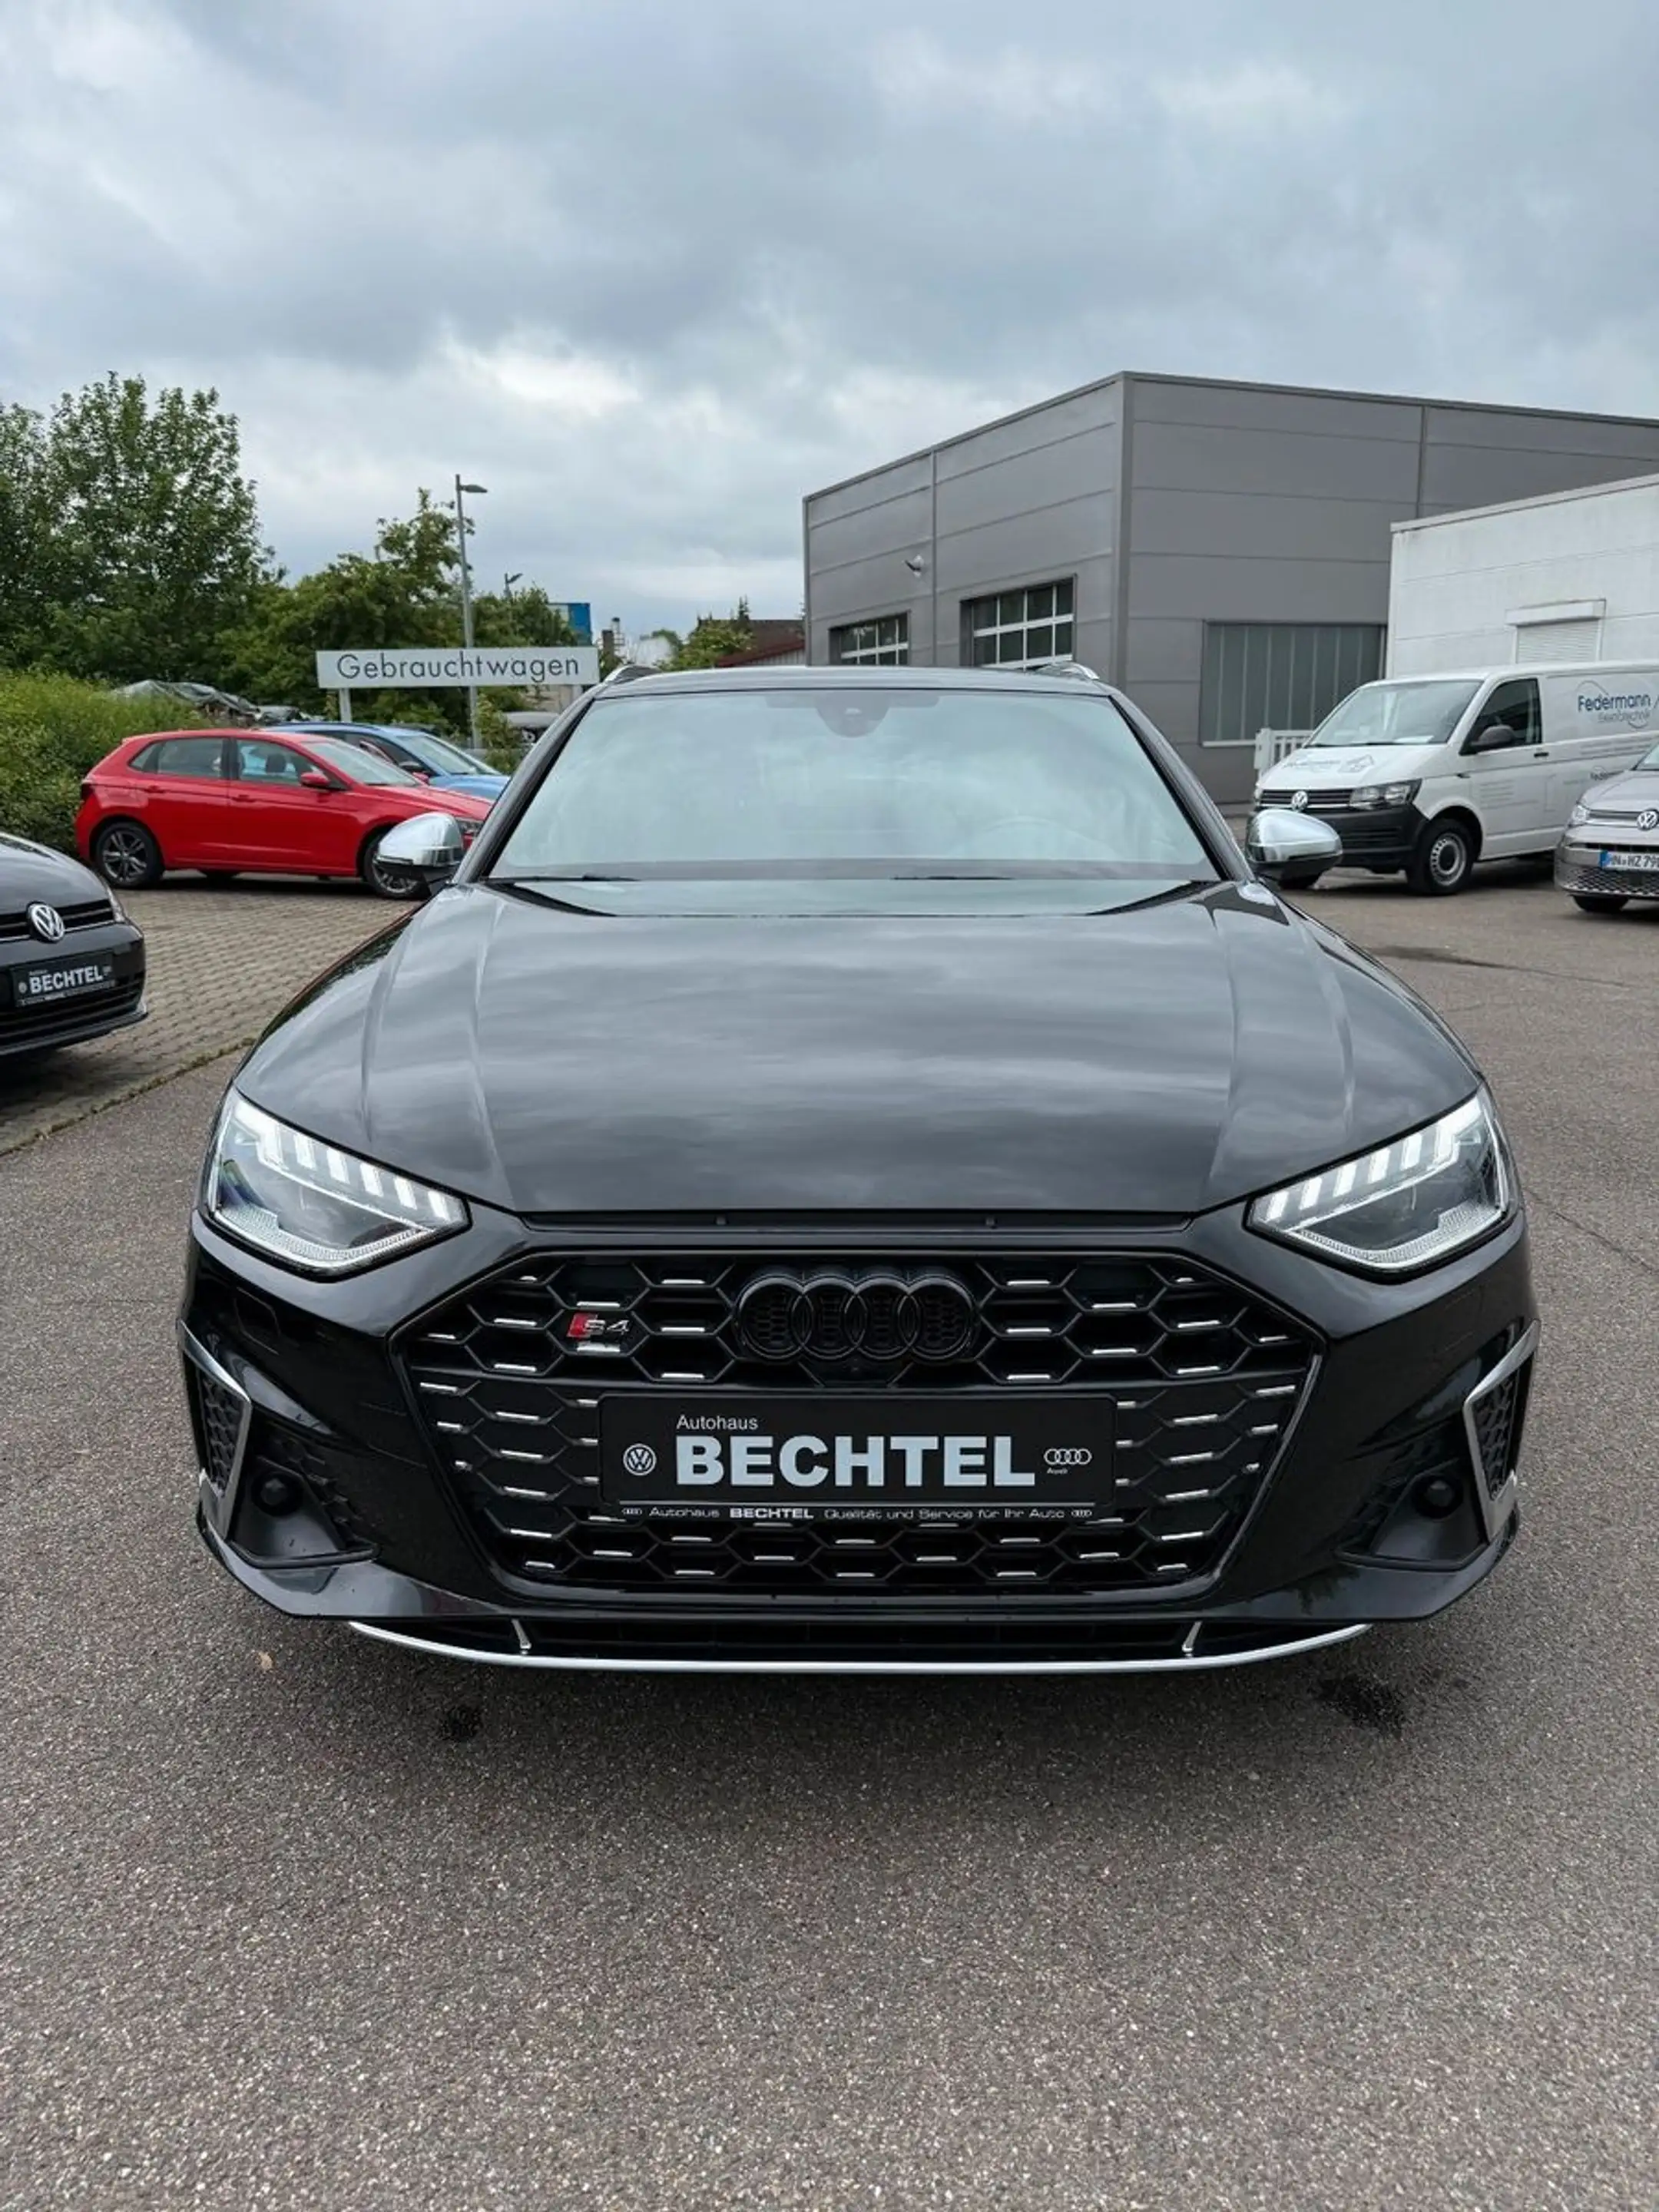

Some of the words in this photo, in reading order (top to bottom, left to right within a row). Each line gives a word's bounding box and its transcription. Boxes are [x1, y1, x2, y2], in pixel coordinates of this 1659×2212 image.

[336, 651, 579, 682] Gebrauchtwagen
[1578, 694, 1651, 712] Federmann
[28, 965, 103, 994] BECHTEL
[676, 1415, 758, 1430] Autohaus
[676, 1435, 1035, 1487] BECHTEL
[649, 1507, 720, 1518] Autohaus
[730, 1508, 814, 1518] BECHTEL
[824, 1508, 882, 1520] Qualität
[886, 1508, 913, 1519] und
[919, 1508, 973, 1519] Service
[979, 1508, 999, 1519] für
[1004, 1508, 1025, 1519] Ihr
[1028, 1508, 1065, 1519] Auto
